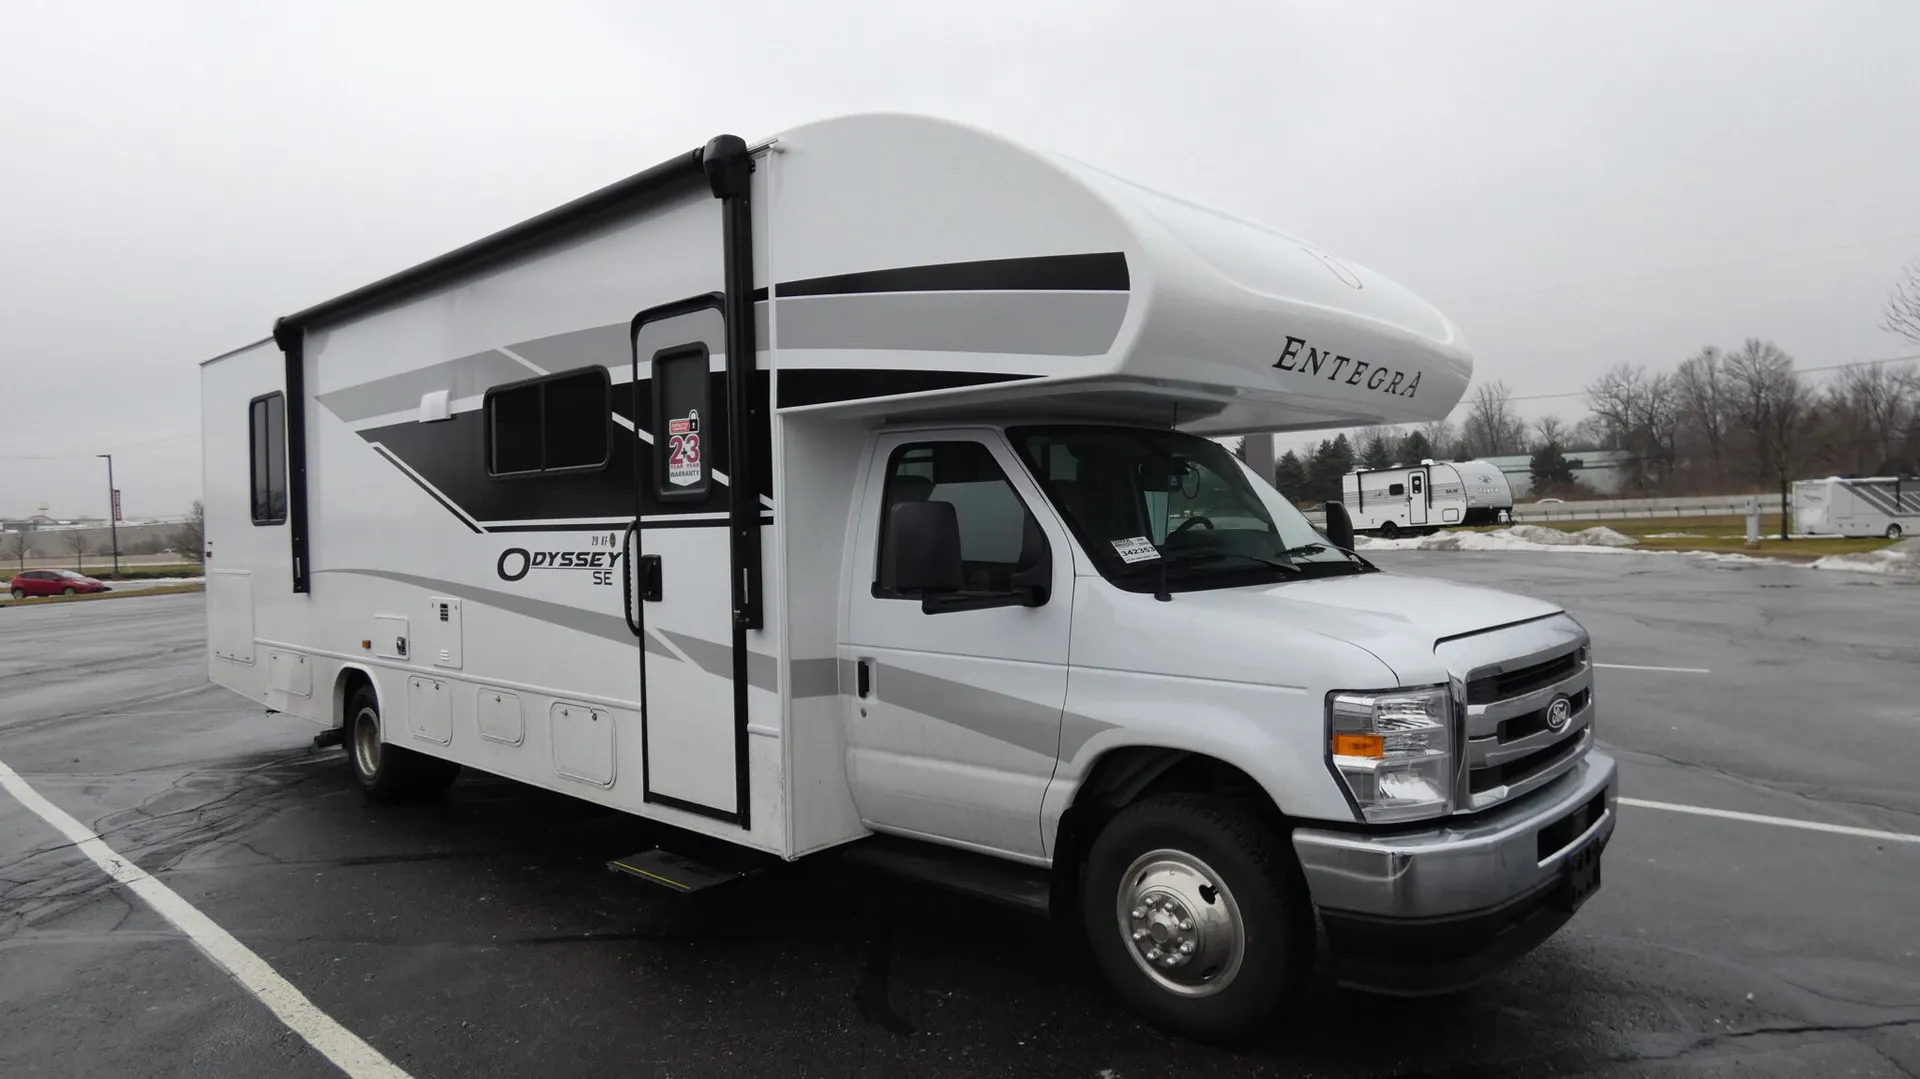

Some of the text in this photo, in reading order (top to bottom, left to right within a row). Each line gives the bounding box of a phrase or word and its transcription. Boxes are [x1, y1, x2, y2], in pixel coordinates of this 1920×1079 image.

[1272, 335, 1421, 398] ENTEGRA
[670, 470, 700, 478] WARRANTY
[497, 547, 623, 582] ODYSSEY
[592, 571, 613, 586] SE
[1552, 703, 1567, 724] Ford
